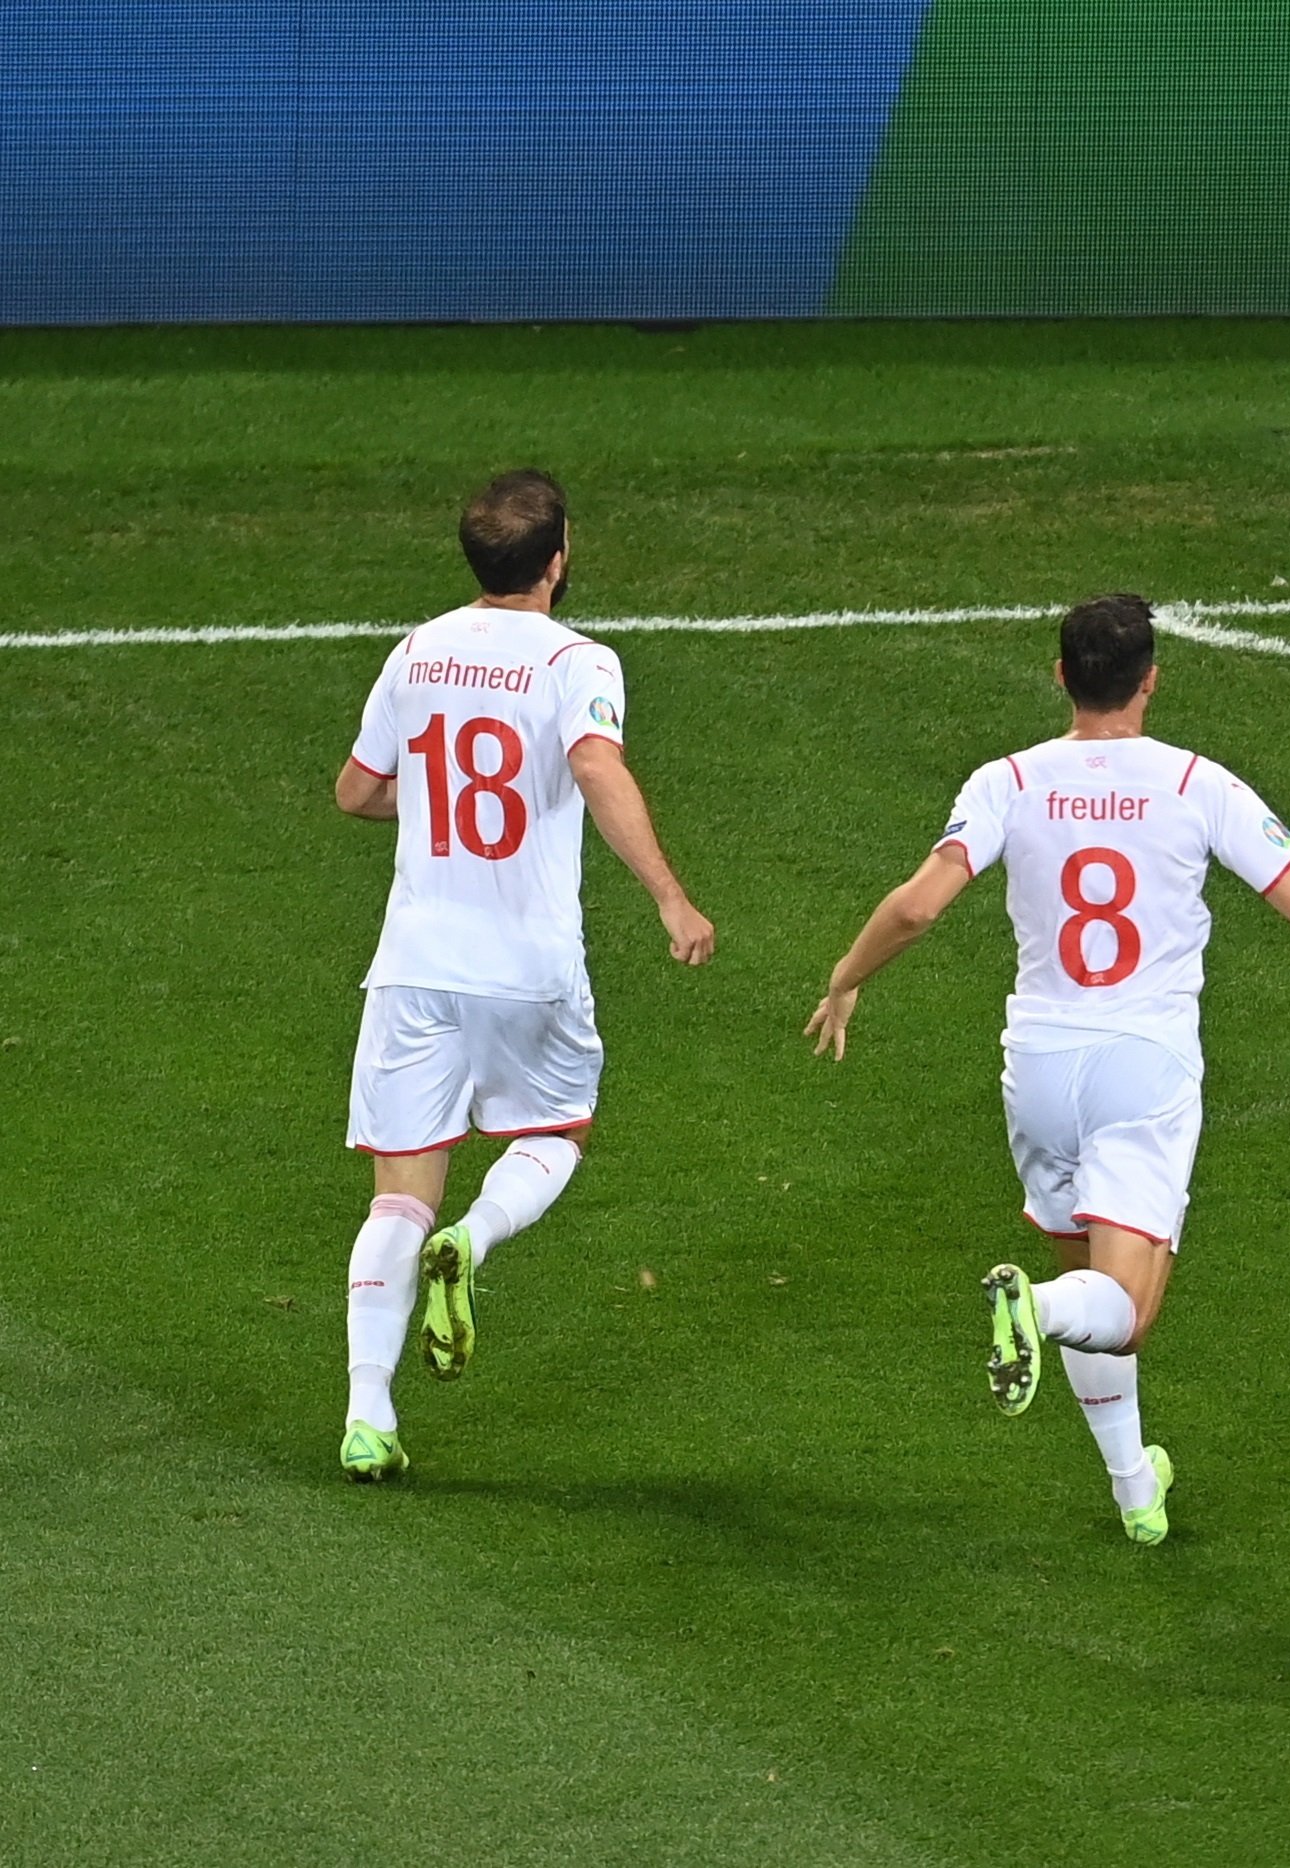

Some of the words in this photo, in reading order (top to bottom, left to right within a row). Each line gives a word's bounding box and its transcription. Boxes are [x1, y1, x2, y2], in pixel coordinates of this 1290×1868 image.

[408, 656, 533, 694] mehmedi
[407, 713, 527, 860] 18
[1046, 791, 1149, 821] freuler
[1059, 847, 1141, 987] 8
